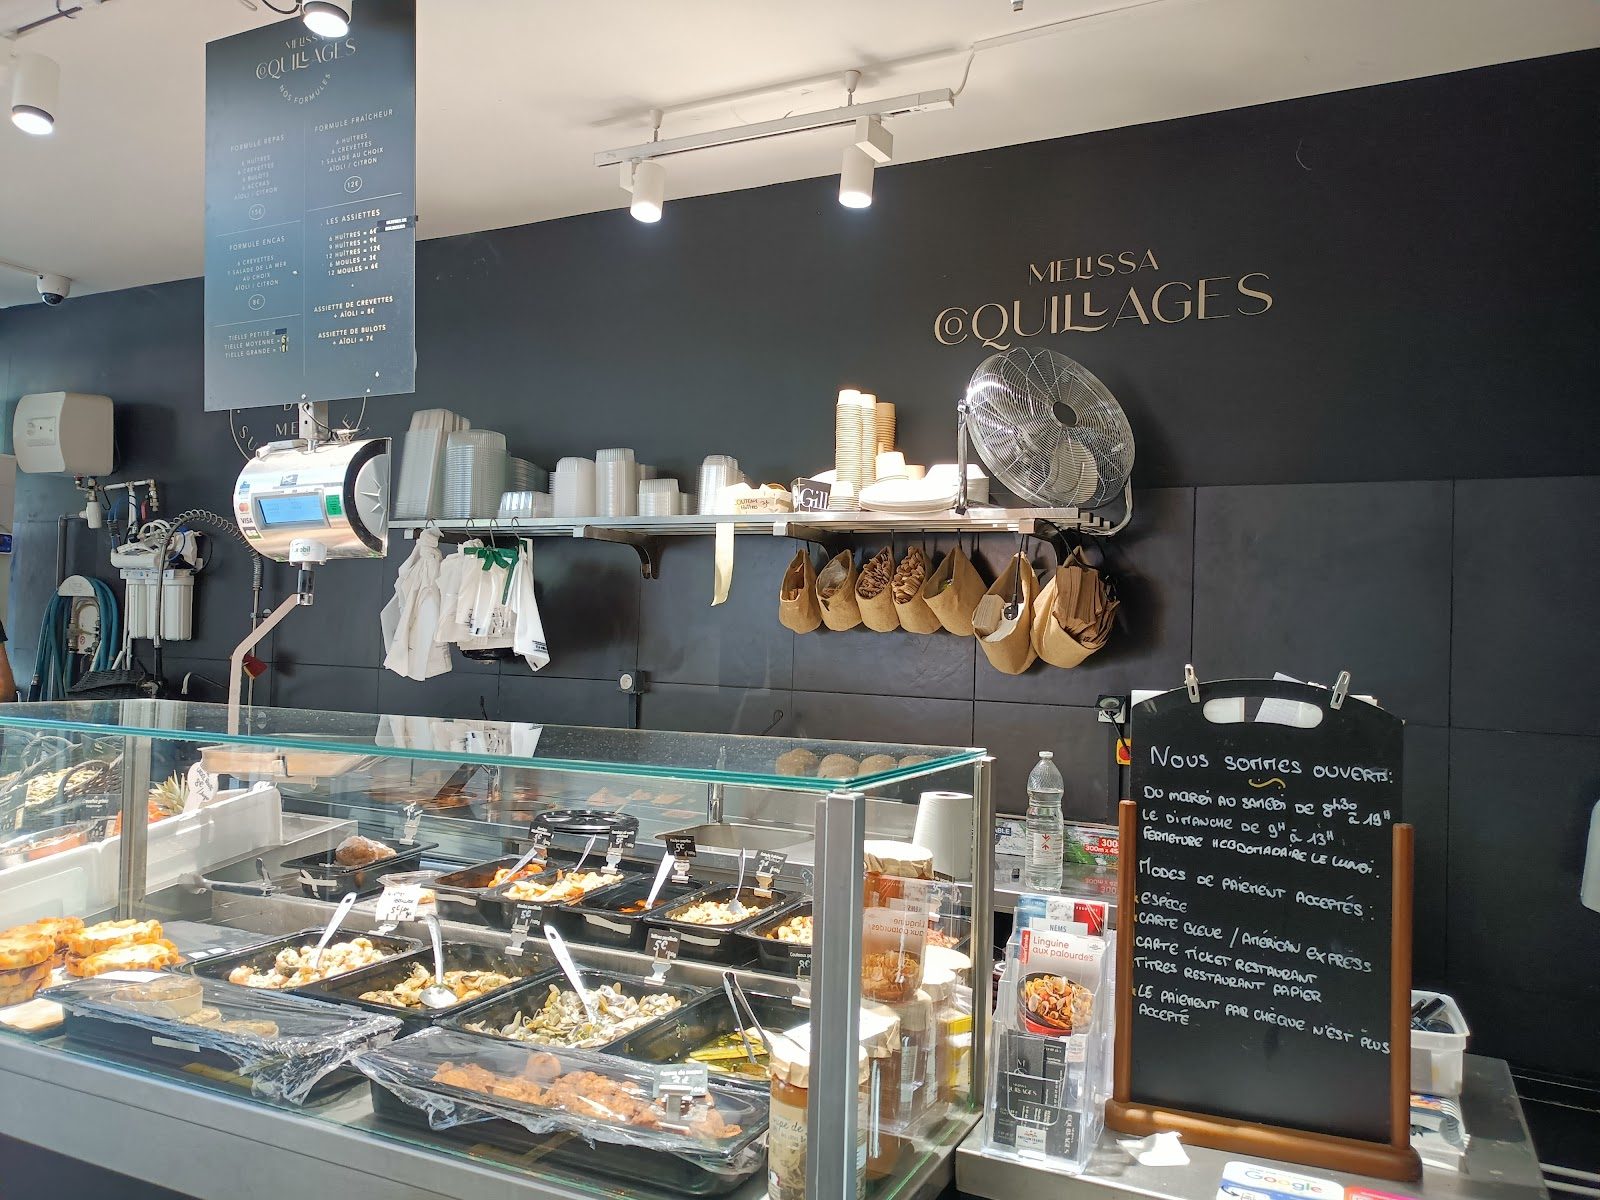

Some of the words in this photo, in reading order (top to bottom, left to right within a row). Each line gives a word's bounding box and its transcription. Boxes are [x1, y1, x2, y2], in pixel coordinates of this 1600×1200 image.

[285, 34, 327, 49] MELISS
[279, 84, 292, 102] NOS
[294, 73, 331, 104] FORMULES
[314, 120, 348, 133] FORMULE
[351, 109, 393, 124] FRAÎCHEUR
[231, 140, 261, 153] FORMULE
[264, 134, 285, 145] REPAS
[341, 133, 368, 144] HUÎTRES
[337, 141, 372, 153] CREVETTES
[326, 154, 350, 165] SALADE
[363, 147, 384, 157] CHOIX
[353, 158, 377, 168] CITRON
[347, 180, 360, 189] 12€
[326, 216, 340, 225] LES
[342, 209, 381, 223] ASSIETTES
[334, 230, 361, 241] HUÎTRES
[229, 241, 261, 251] FORMULE
[263, 236, 285, 246] ENCAS
[334, 239, 361, 249] HUÎTRES
[335, 247, 361, 257] HUÎTRES
[369, 245, 381, 253] 12€
[232, 266, 254, 275] SALADE
[275, 261, 287, 269] MER
[335, 257, 360, 266] MOULES
[1029, 248, 1160, 286] MELISSA
[253, 273, 271, 281] CHOIX
[337, 265, 362, 275] MOULES
[256, 280, 279, 288] CITRON
[314, 302, 343, 313] ASSIETTE
[346, 301, 354, 309] DE
[356, 295, 394, 307] CREVETTES
[340, 309, 358, 318] AÏOLI
[934, 272, 1274, 351] COQUILLAGES
[318, 329, 347, 338] ASSIETTE
[349, 328, 359, 336] DE
[361, 324, 386, 334] BULOTS
[224, 342, 244, 350] TIELLE
[246, 339, 275, 348] MOYENNE
[339, 337, 357, 345] AÏOLI
[225, 350, 244, 359] TIELLE
[246, 347, 271, 356] GRANDE
[800, 488, 830, 510] Gill
[1143, 785, 1163, 799] DU
[1217, 795, 1236, 808] AU
[1294, 802, 1315, 816] DE
[1142, 809, 1158, 821] LE
[1241, 821, 1260, 835] DE
[1311, 851, 1327, 865] LE
[1196, 874, 1214, 888] DE
[1049, 923, 1068, 933] NEMS
[1139, 911, 1179, 930] CARTE
[1183, 922, 1223, 940] BLEUE
[1033, 936, 1070, 949] Linguine
[1032, 946, 1048, 956] aux
[1050, 948, 1094, 962] palourdes
[1135, 935, 1179, 955] CARTE
[1235, 960, 1318, 984] RESTAURANT
[1184, 967, 1266, 991] RESTAURANT
[1137, 984, 1153, 999] LE
[1225, 1003, 1249, 1018] PAR
[1245, 1170, 1322, 1193] Google
